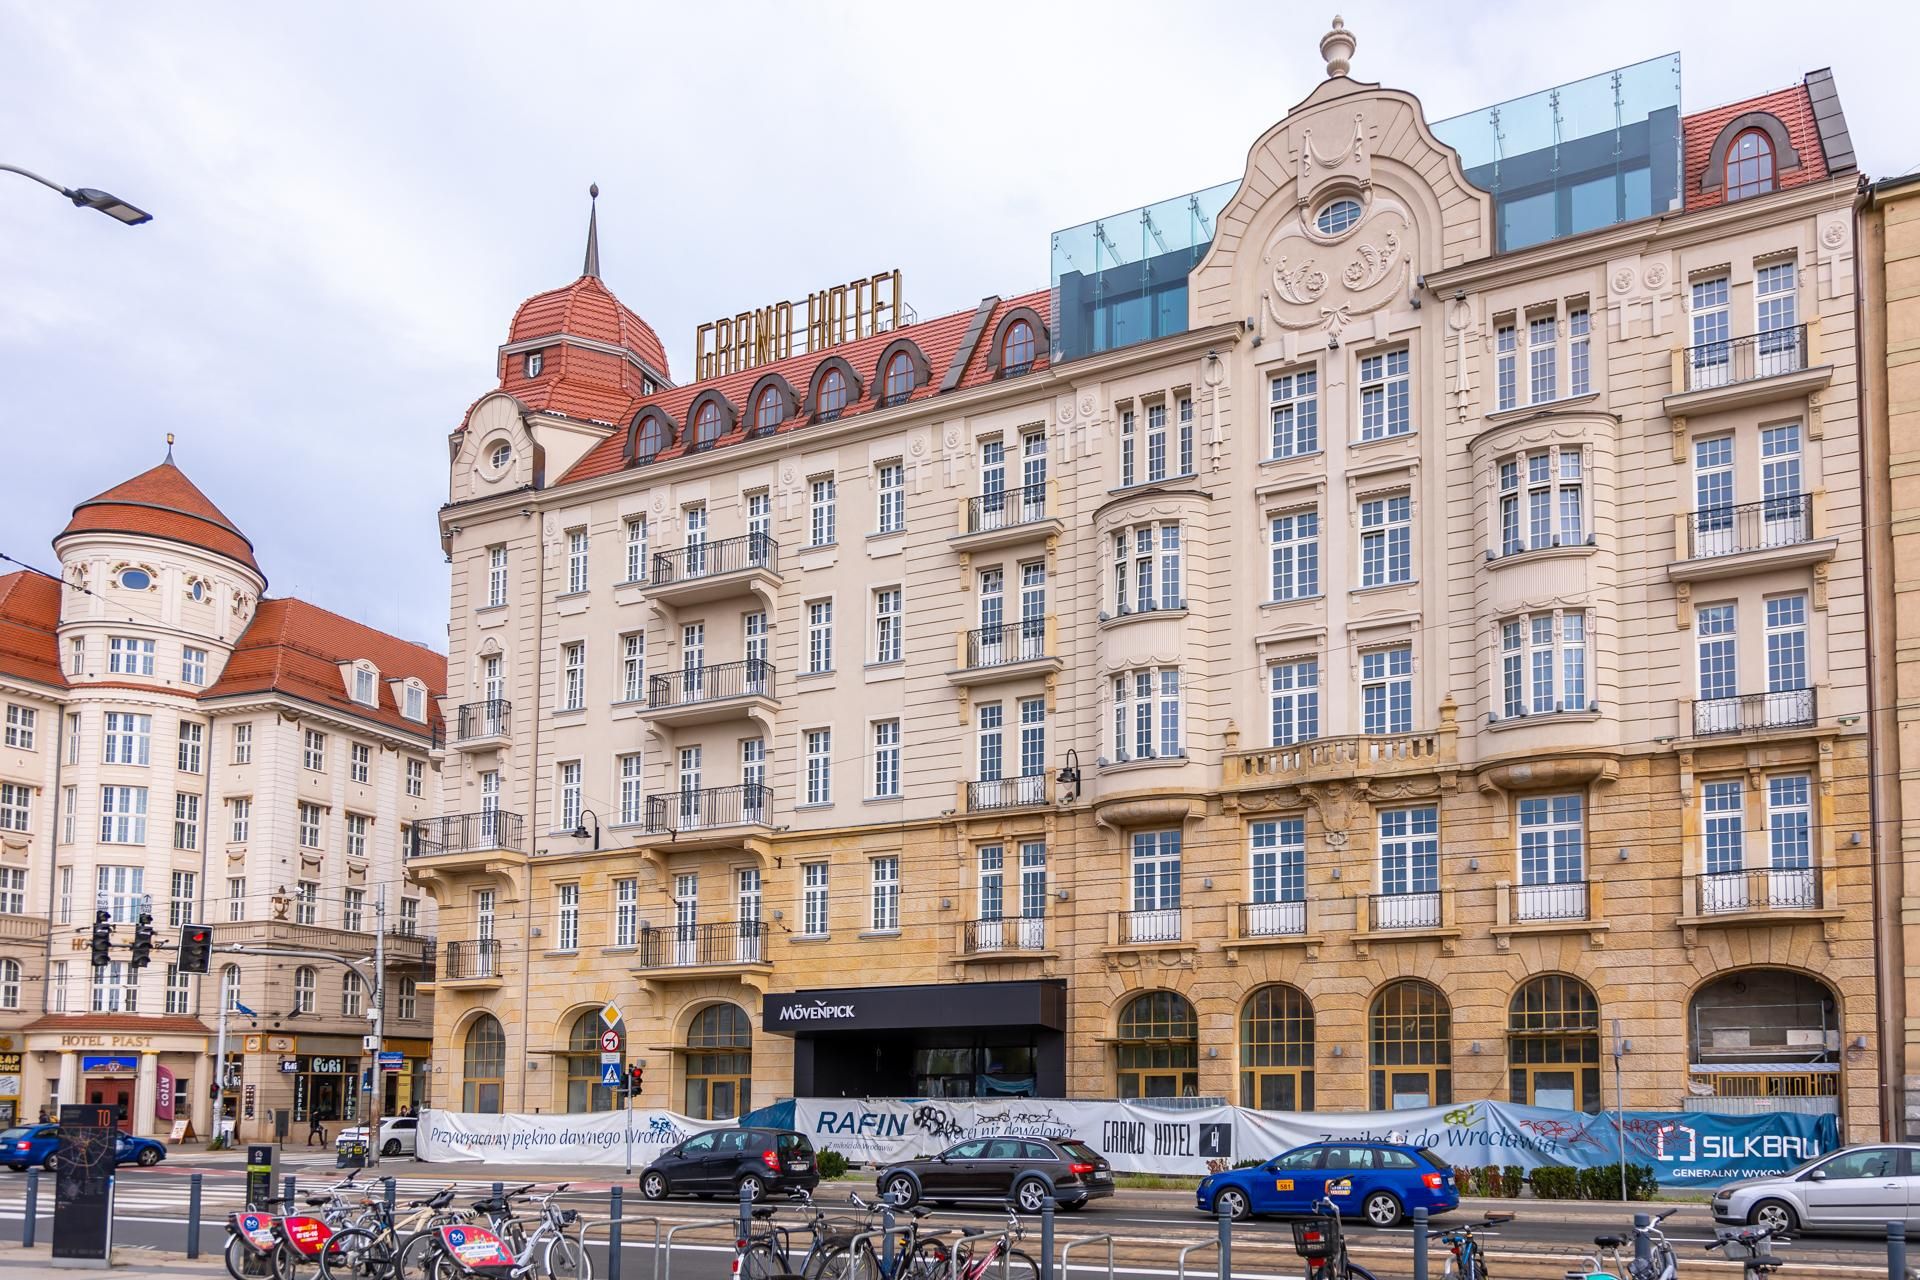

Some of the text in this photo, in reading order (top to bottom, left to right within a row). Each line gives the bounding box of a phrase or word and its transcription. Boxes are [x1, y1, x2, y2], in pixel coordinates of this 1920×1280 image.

[695, 268, 910, 383] GRAND HOTEL
[779, 1001, 855, 1020] MÖVENPICK
[62, 1035, 153, 1047] HOTEL PIAST
[816, 1111, 909, 1137] RAFIN
[431, 1127, 510, 1150] Przywracamy
[512, 1127, 557, 1150] piękno
[559, 1128, 621, 1149] dawnego
[1103, 1120, 1194, 1156] GRAND HOTEL
[1414, 1127, 1440, 1148] do
[1447, 1126, 1558, 1155] Wrocławia
[1703, 1135, 1820, 1160] SILKBAU
[1672, 1168, 1739, 1178] GENERALNY
